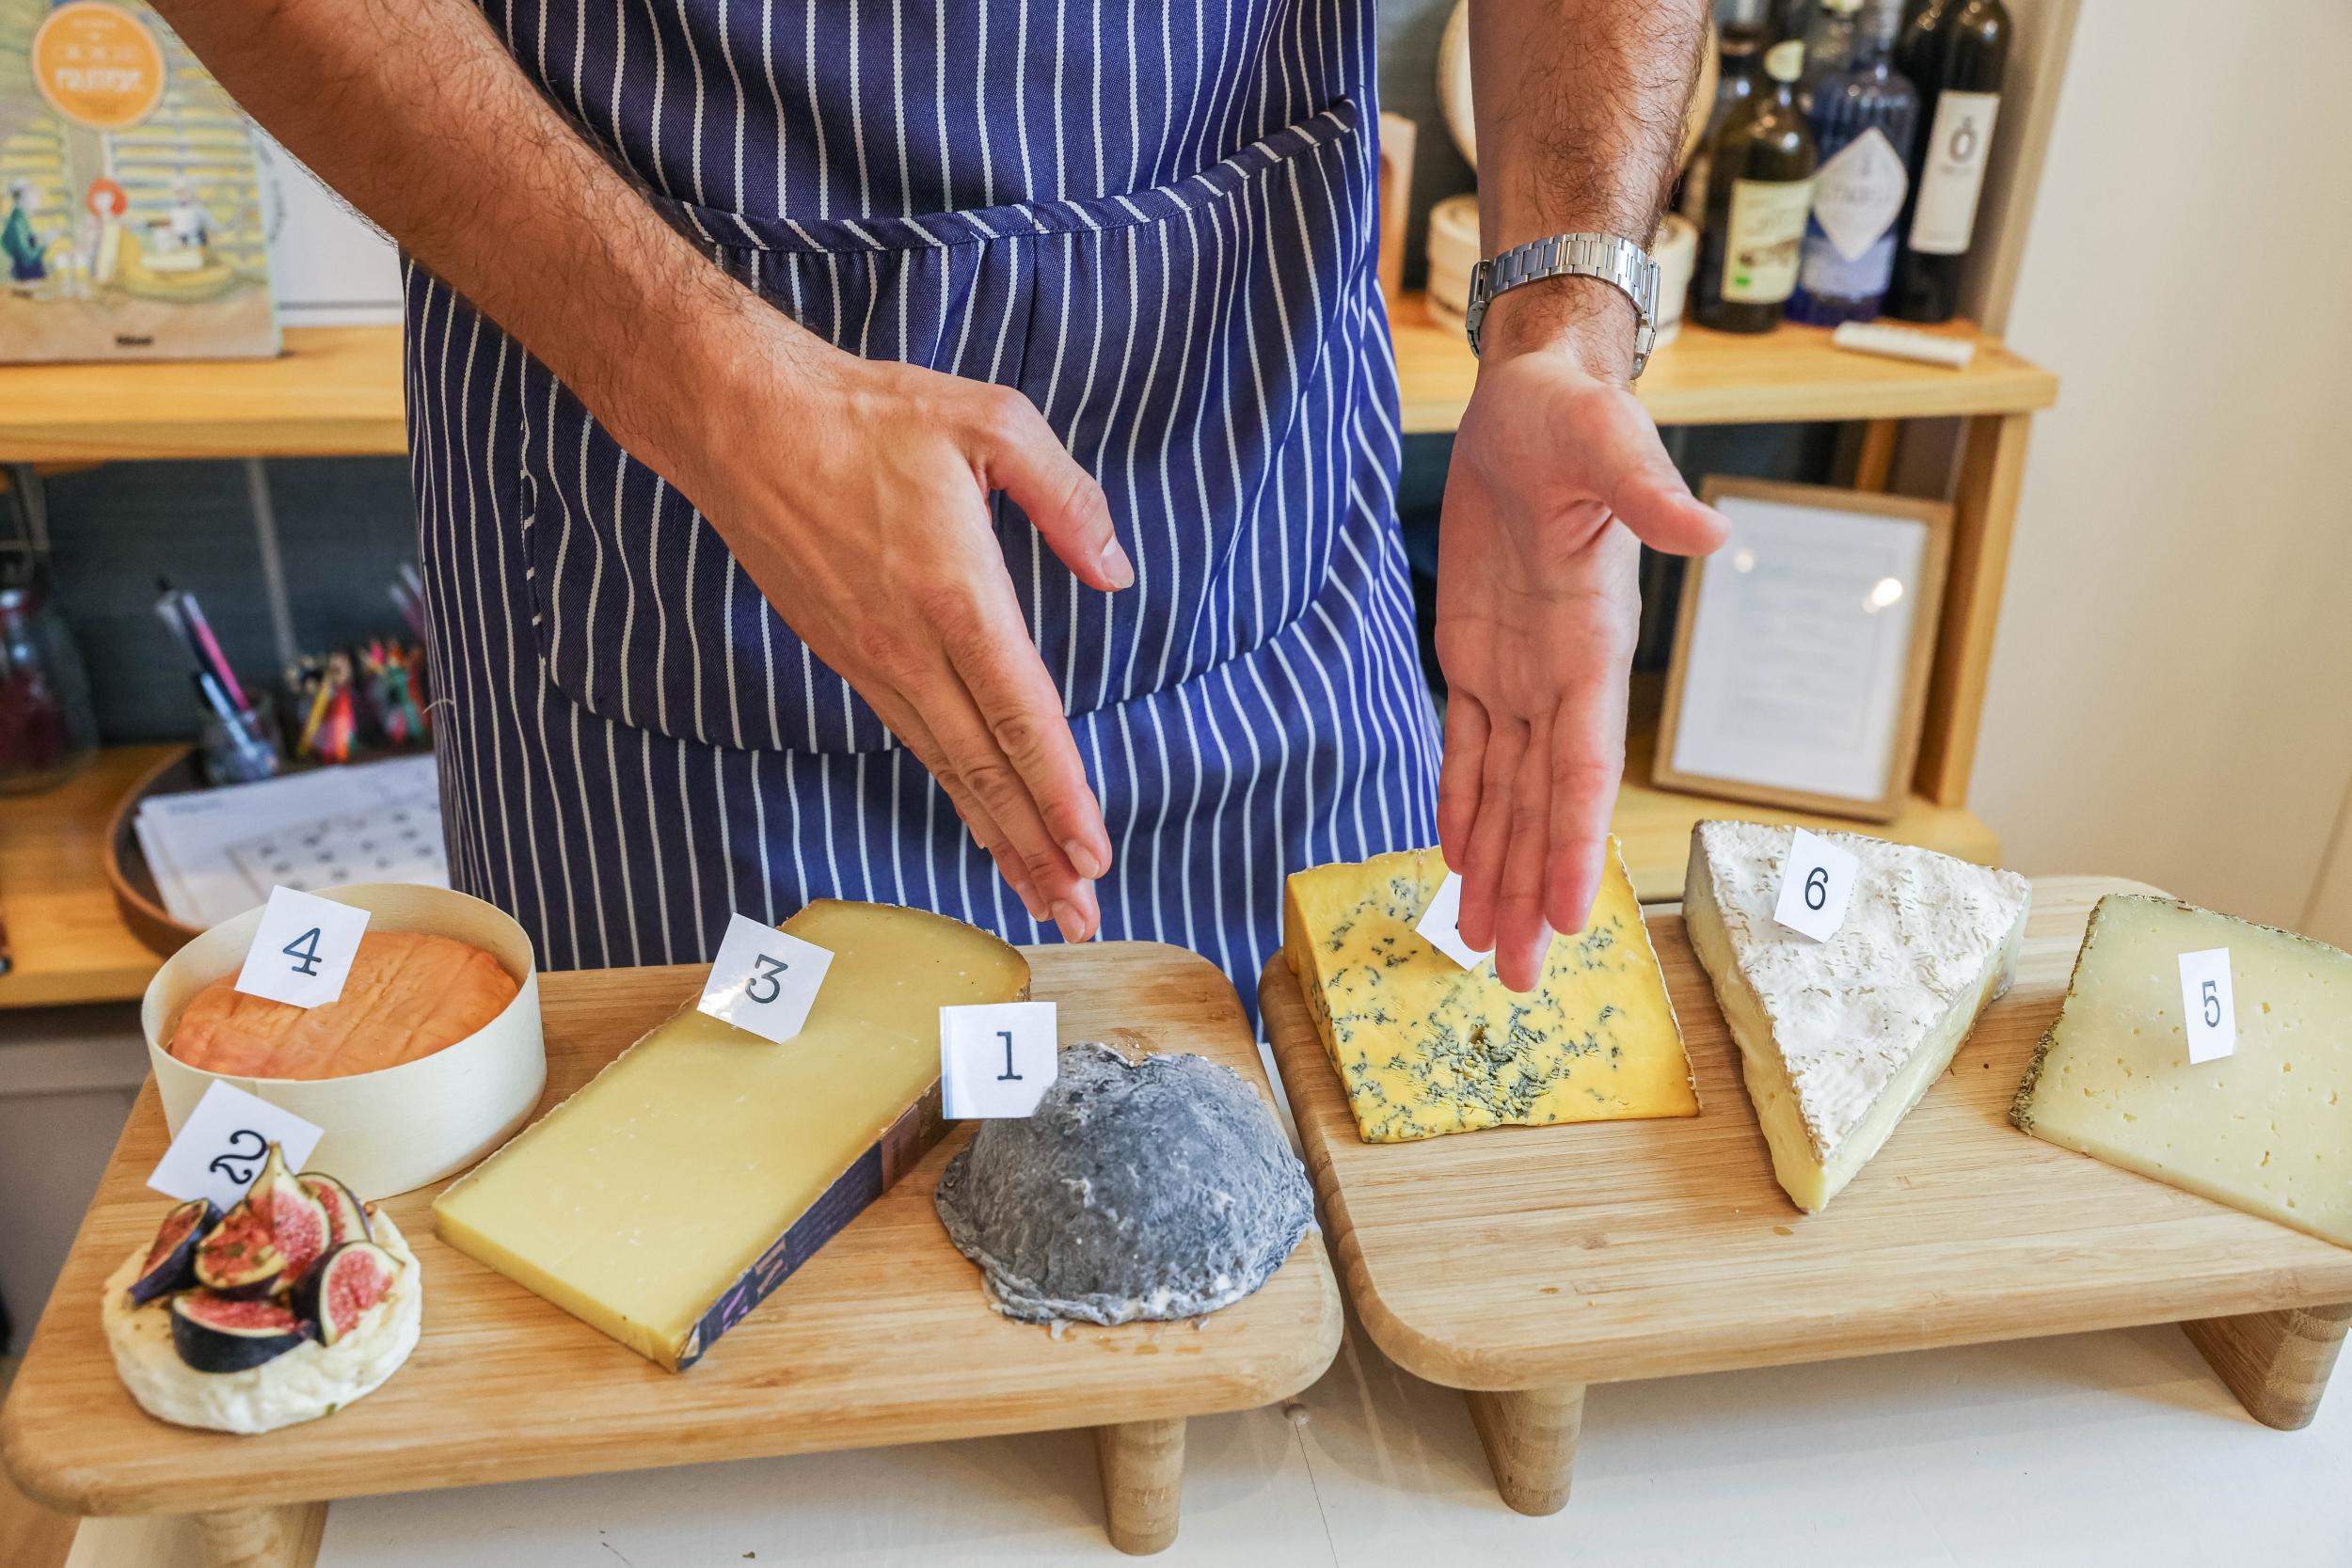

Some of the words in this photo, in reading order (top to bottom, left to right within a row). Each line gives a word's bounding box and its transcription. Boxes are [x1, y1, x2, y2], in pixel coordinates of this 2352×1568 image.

[1804, 866, 1829, 911] 6
[282, 927, 322, 976] 4
[745, 953, 788, 1004] 3
[2201, 980, 2221, 1028] 5
[996, 1031, 1023, 1081] 1
[209, 1129, 268, 1185] 2
